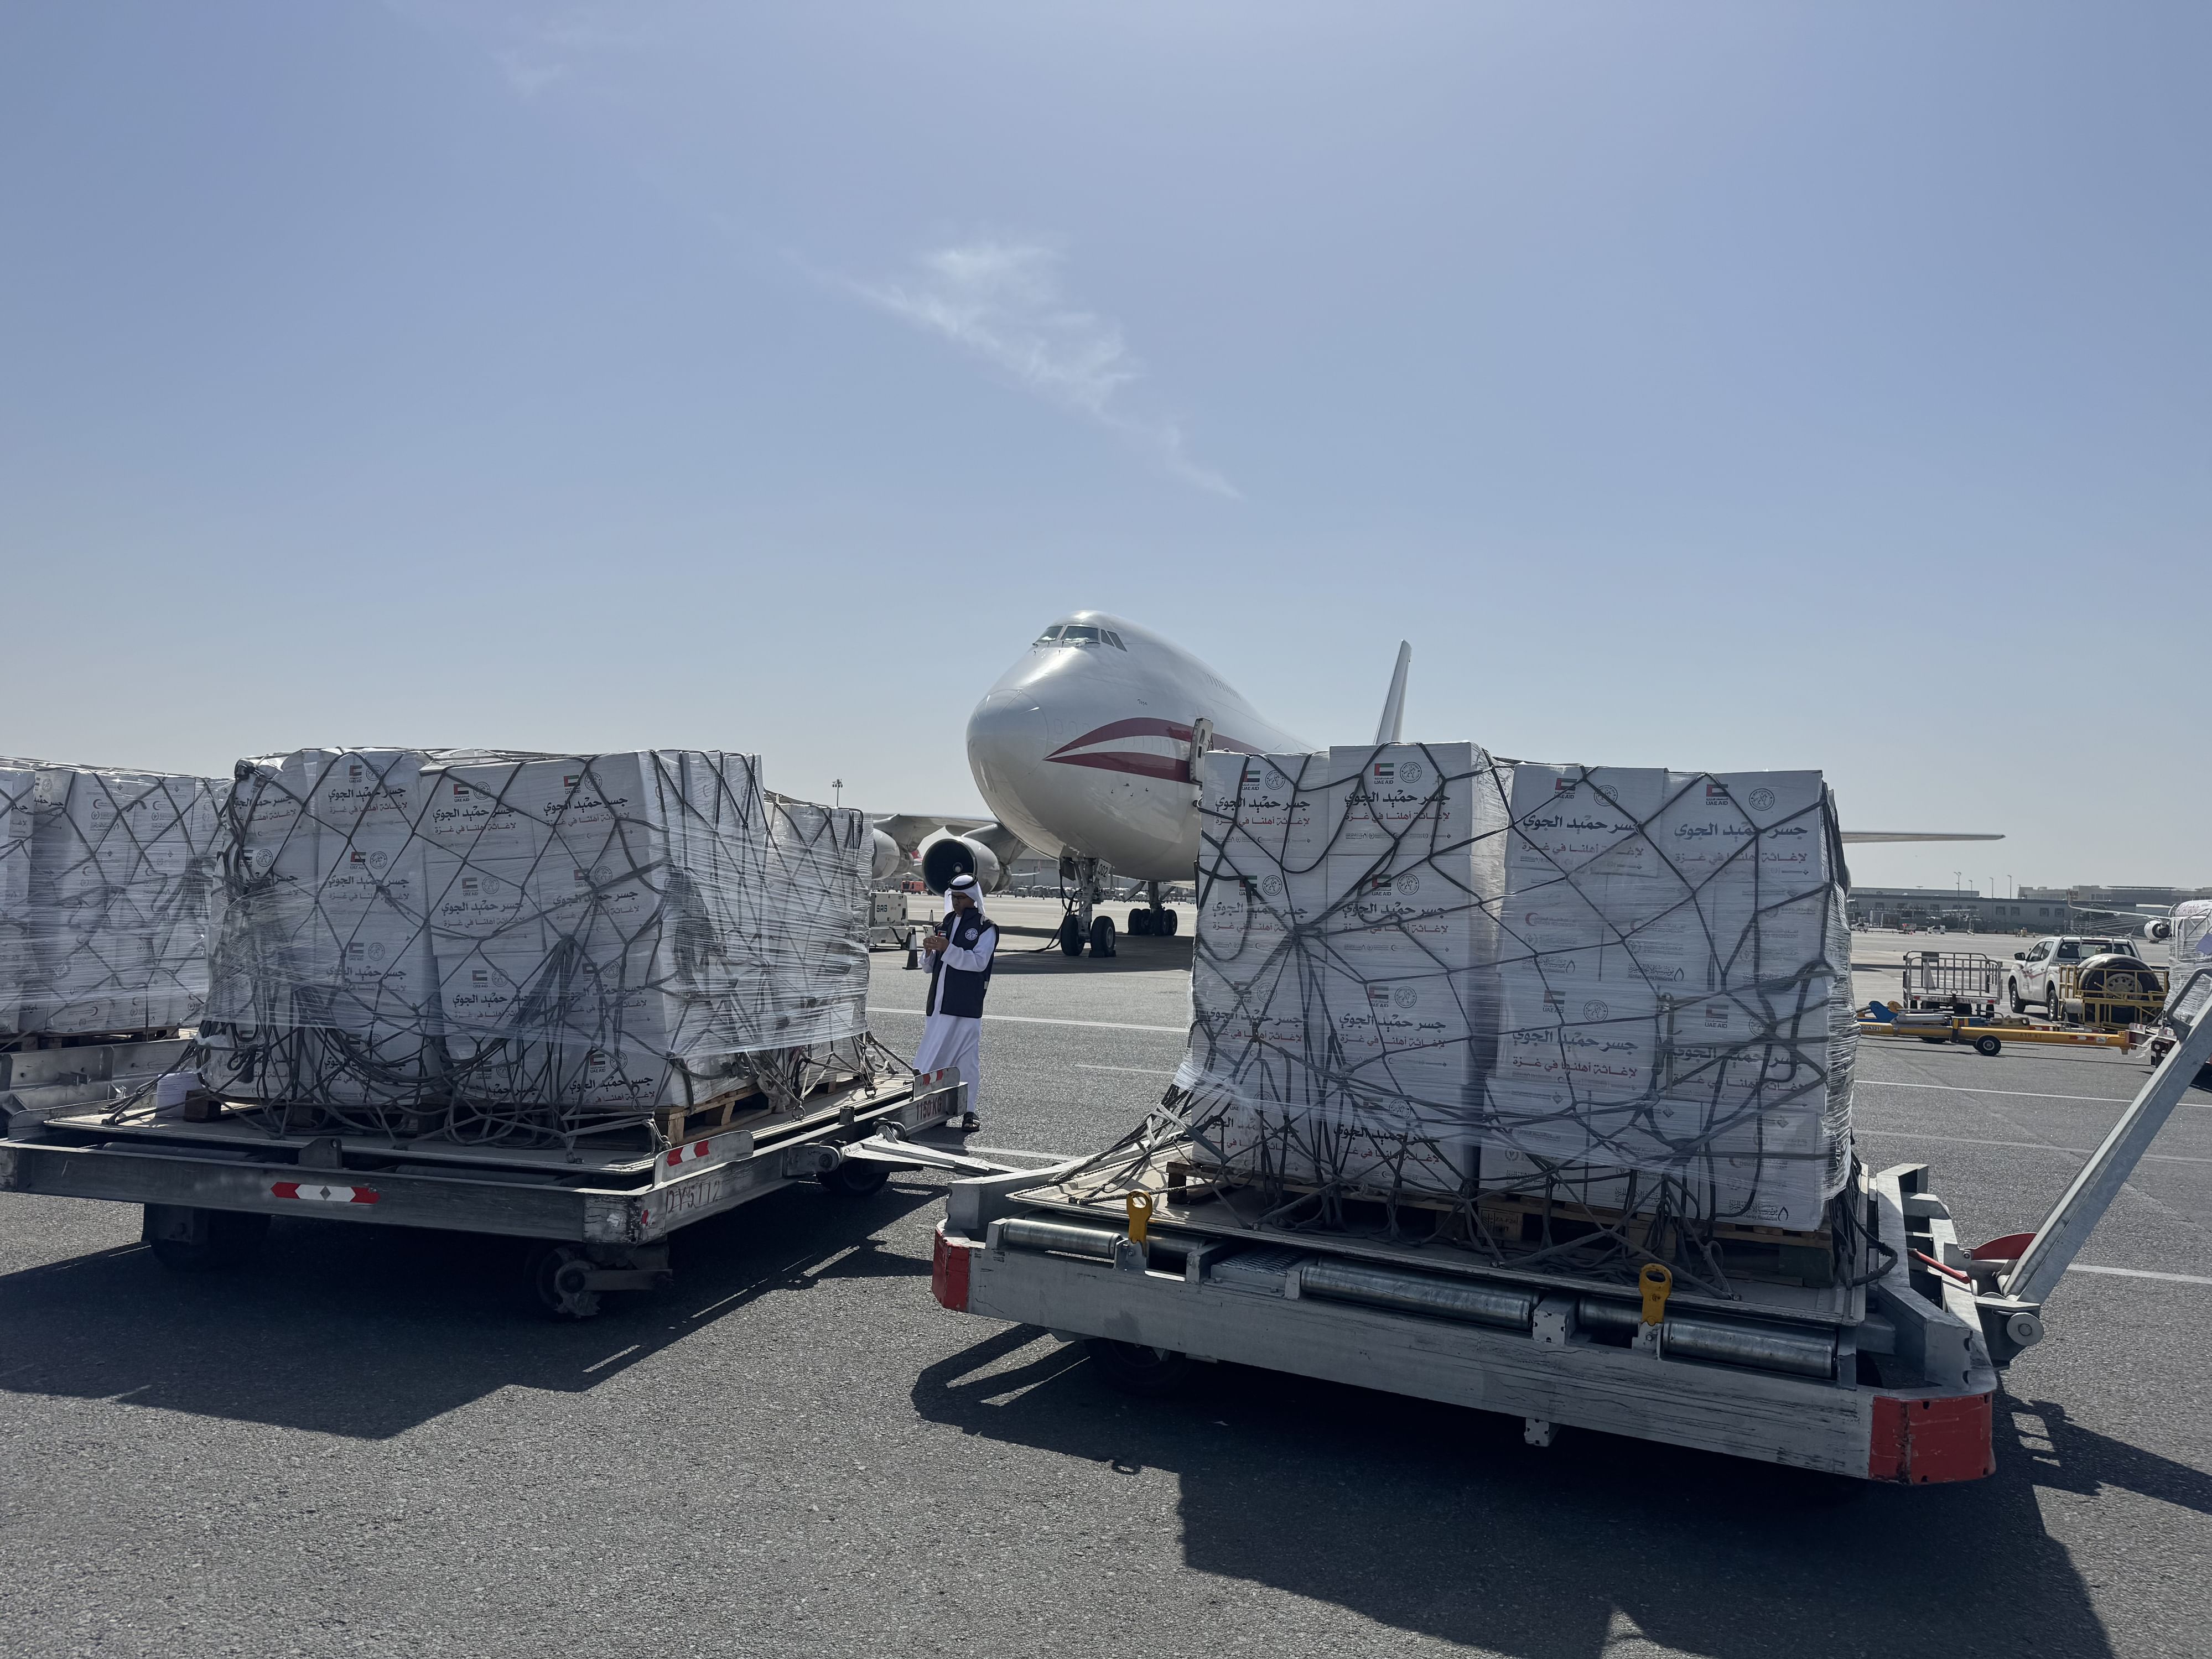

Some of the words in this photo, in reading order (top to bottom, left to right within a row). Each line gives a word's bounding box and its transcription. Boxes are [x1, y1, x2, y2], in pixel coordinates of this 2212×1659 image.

[328, 789, 353, 802] الجوي
[433, 808, 459, 823] الجوي
[579, 814, 599, 823] أهلنا
[489, 823, 516, 831] لإغاثة
[568, 818, 577, 827] في
[1239, 818, 1249, 826] في
[1277, 818, 1310, 826] لإغثة
[1523, 815, 1562, 831] الجوي
[456, 825, 465, 834] في
[1674, 822, 1717, 841] الجوي
[1768, 828, 1808, 839] جسر
[1552, 844, 1566, 854] في
[1570, 844, 1598, 853] أهلنا
[1675, 853, 1706, 862] غزة
[1762, 853, 1807, 864] لإغاثة
[1098, 864, 1108, 877] 002
[329, 875, 353, 888] الجوي
[614, 892, 638, 902] جسر
[442, 902, 468, 916] الجوي
[611, 906, 639, 915] لإغاثة
[1213, 902, 1243, 917] الجوي
[465, 919, 473, 928] في
[1213, 922, 1234, 930] غزة
[1412, 925, 1448, 934] لإغاثة
[453, 994, 477, 1007] الجوي
[1274, 1018, 1302, 1028] جسر
[1339, 1013, 1374, 1028] الجوي
[1414, 1022, 1446, 1033] جسر
[1231, 1029, 1241, 1039] في
[1269, 1032, 1302, 1043] لإغاثة
[1340, 1034, 1364, 1043] غزة
[1367, 1036, 1379, 1046] في
[1599, 1042, 1638, 1055] جسر
[1513, 1057, 1541, 1067] غزة
[1545, 1060, 1557, 1072] في
[1593, 1065, 1637, 1078] لإغاثة
[916, 1099, 931, 1121] 1150
[1227, 1138, 1237, 1148] في
[1361, 1148, 1372, 1158] في
